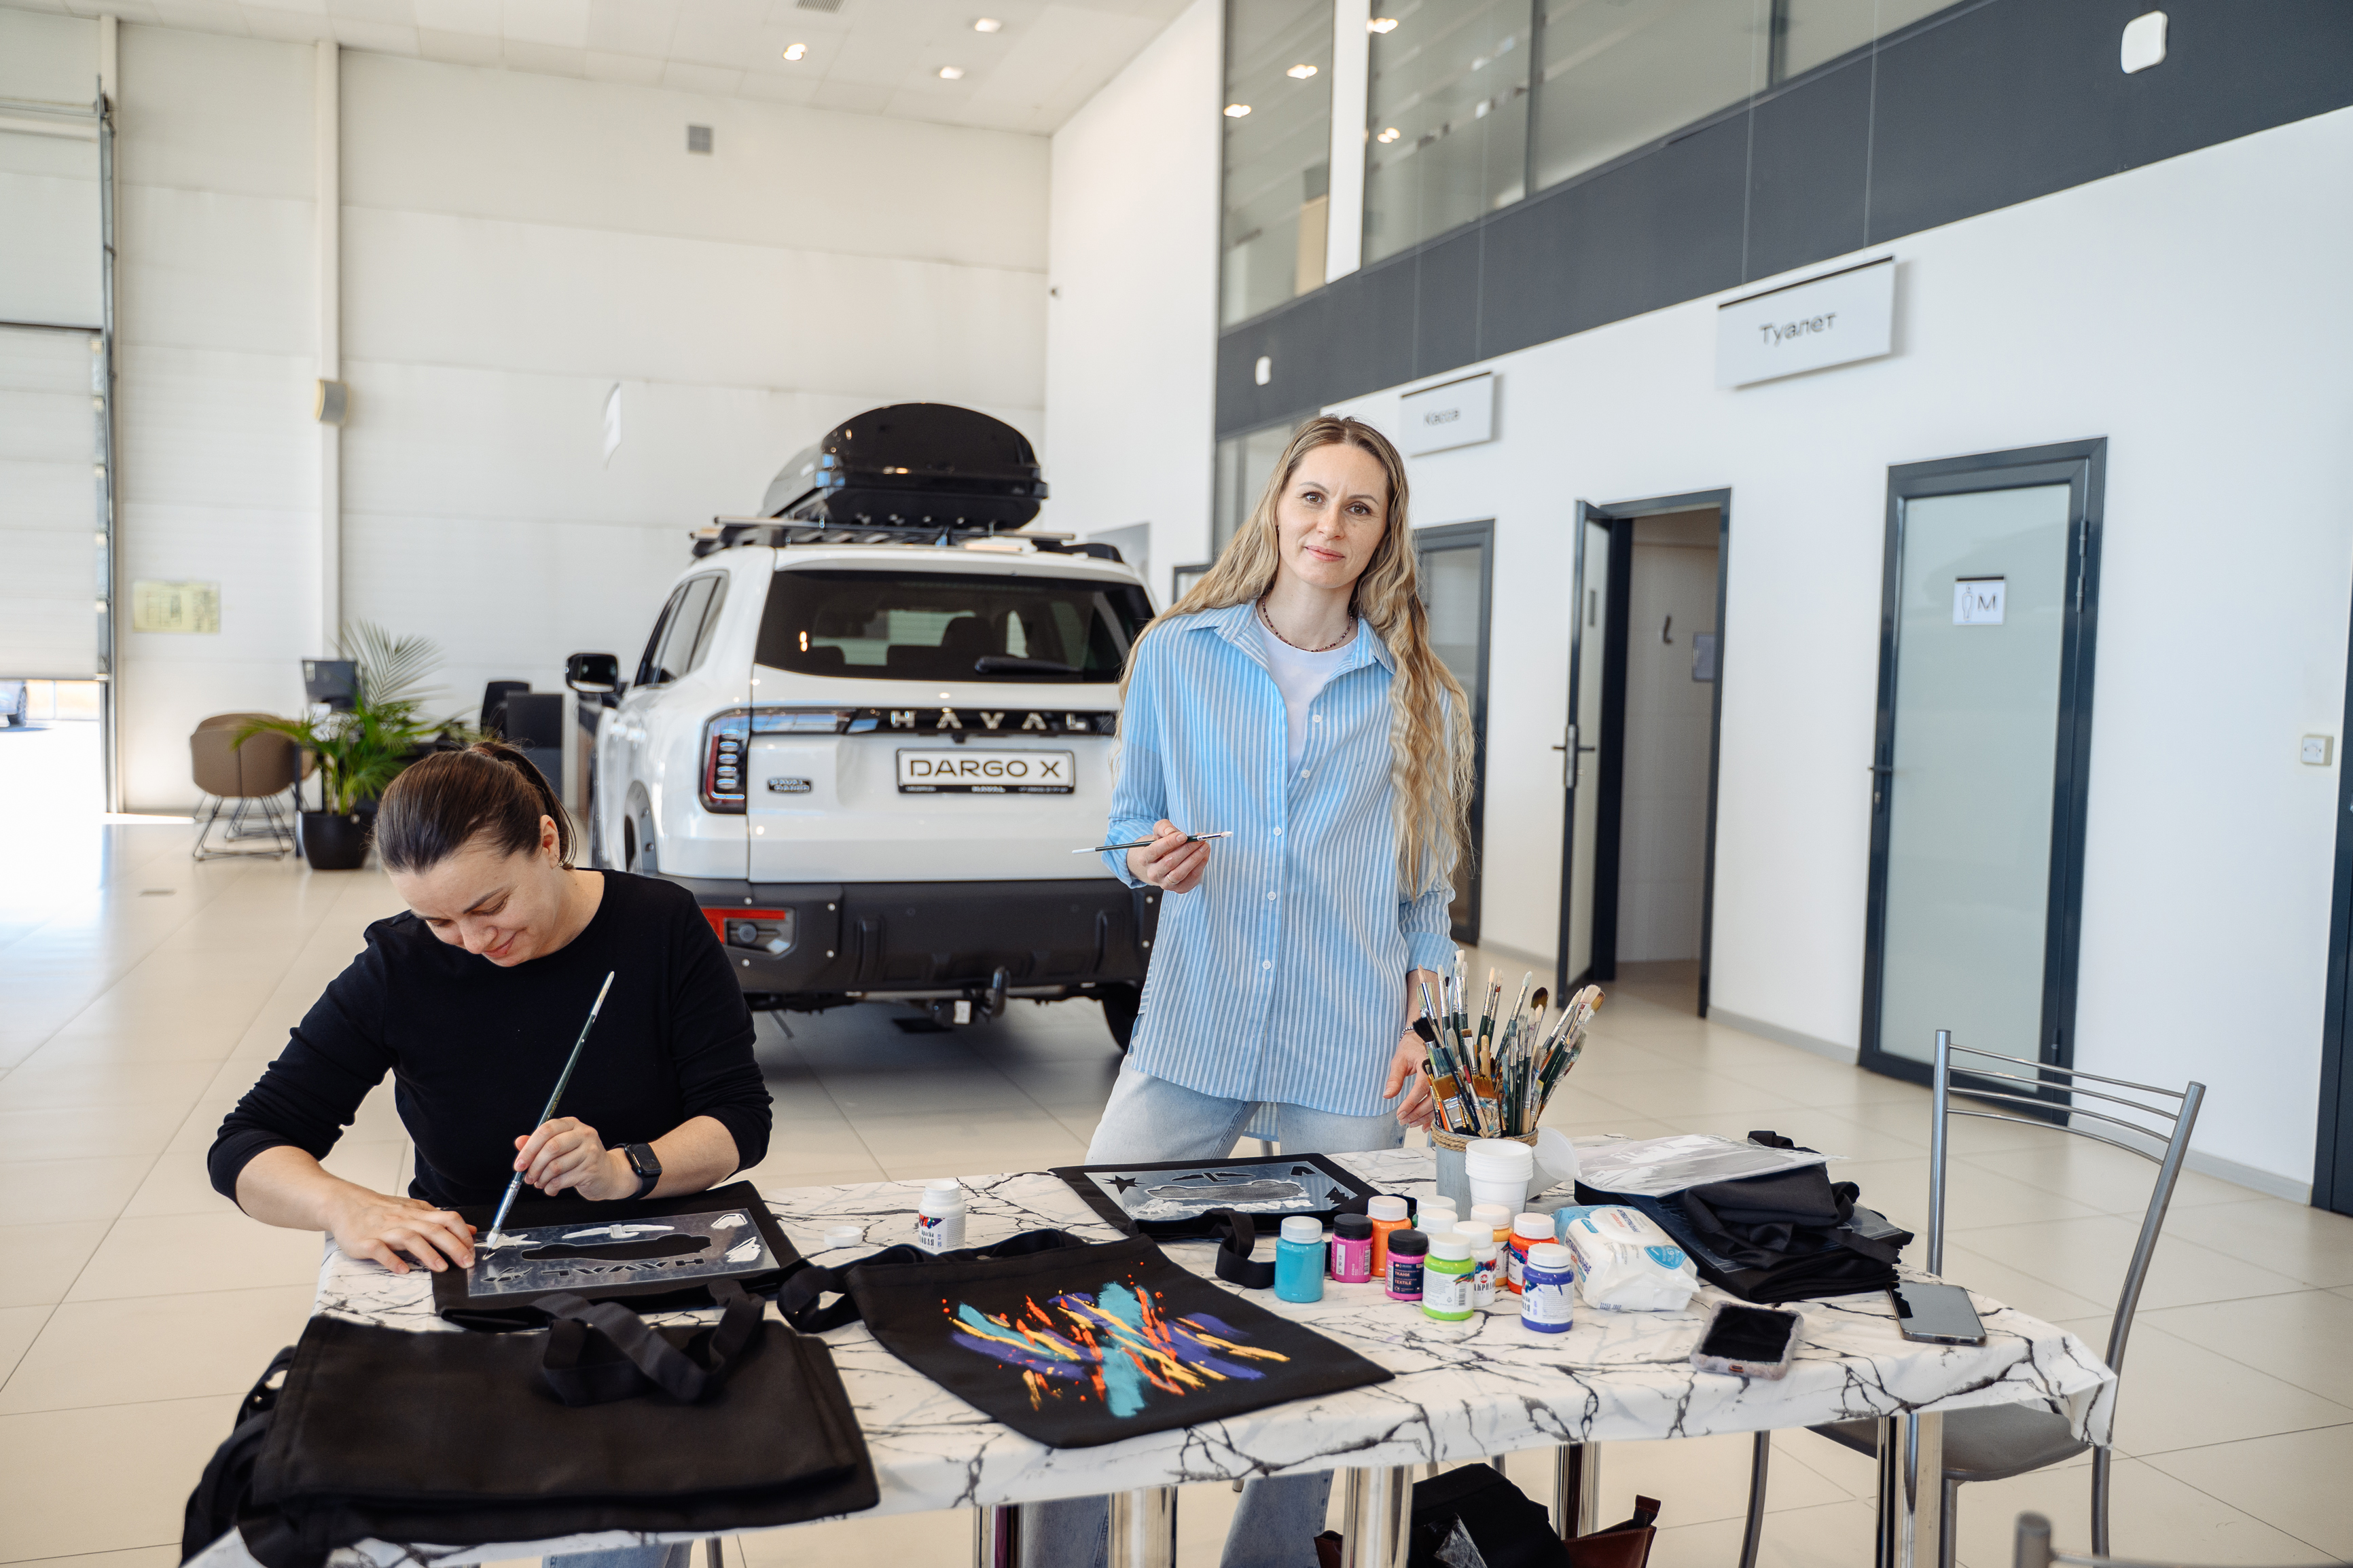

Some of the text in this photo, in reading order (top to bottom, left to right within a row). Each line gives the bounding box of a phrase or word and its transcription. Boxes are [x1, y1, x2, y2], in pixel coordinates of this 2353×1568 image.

[1759, 312, 1837, 347] Туалет
[1977, 593, 1996, 610] М
[891, 710, 1086, 730] HAVAL
[910, 760, 1060, 777] DARGO X
[541, 1258, 706, 1277] HAVAL
